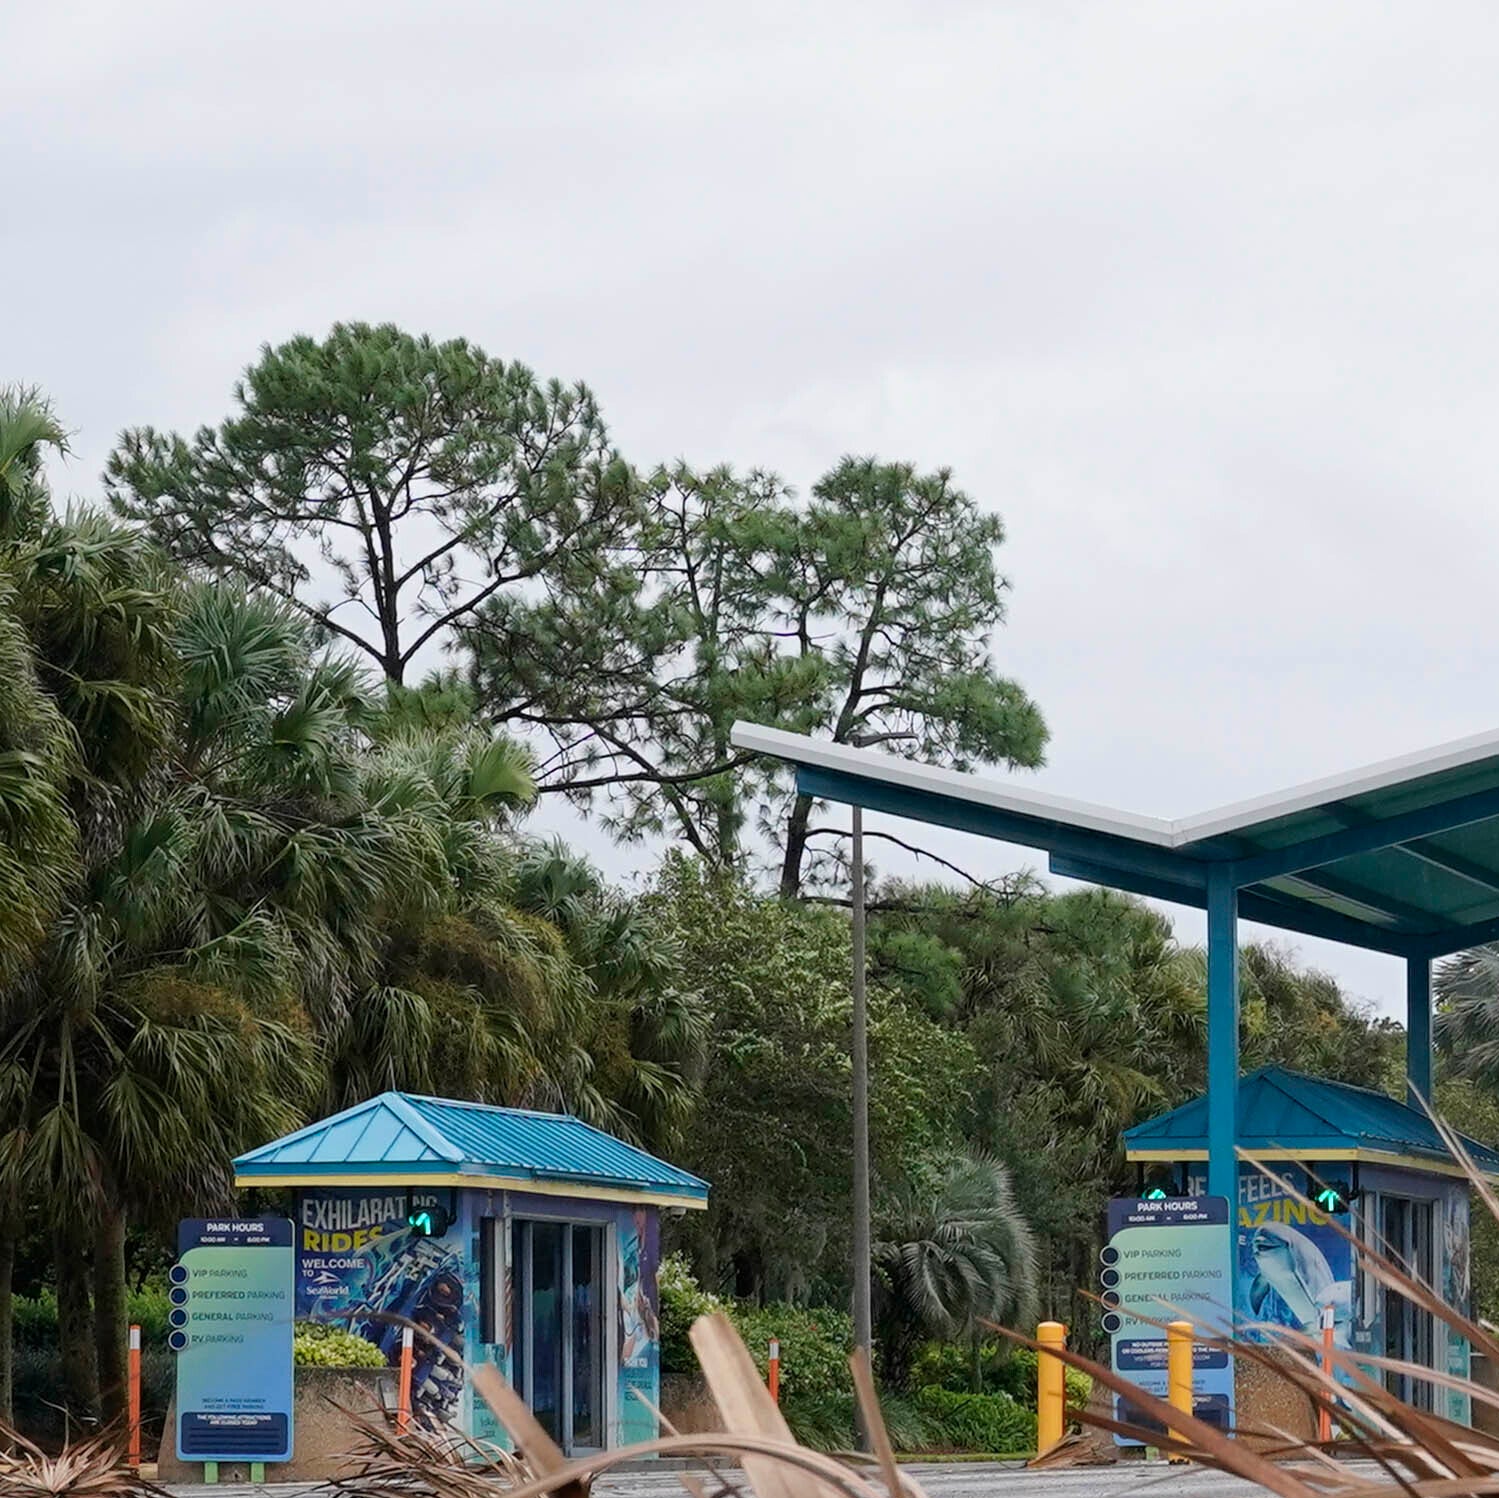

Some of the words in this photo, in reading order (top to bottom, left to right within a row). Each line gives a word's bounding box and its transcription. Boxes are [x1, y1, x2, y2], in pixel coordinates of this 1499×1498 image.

[1238, 1173, 1293, 1204] FEELS
[1137, 1202, 1162, 1212] PARK
[1164, 1201, 1198, 1211] HOURS
[303, 1196, 437, 1230] EXHILARAT
[1238, 1198, 1329, 1228] AZIN
[206, 1223, 231, 1232] PARK
[232, 1223, 264, 1232] HOURS
[1123, 1250, 1140, 1258] VIP
[1142, 1249, 1182, 1258] PARKING
[302, 1259, 364, 1269] WELCOME
[193, 1269, 208, 1278] VIP
[209, 1269, 248, 1278] PARKING
[1124, 1271, 1180, 1280] PREFERRED
[1182, 1270, 1222, 1279] PARKING
[306, 1286, 349, 1295] SeaWorld
[192, 1291, 245, 1300] PREFERRED
[247, 1291, 285, 1300] PARKING
[192, 1312, 233, 1321] GENERAL
[235, 1312, 273, 1321] PARKING
[1125, 1317, 1137, 1325] RV
[192, 1335, 204, 1343] RV
[205, 1335, 244, 1343] PARKING
